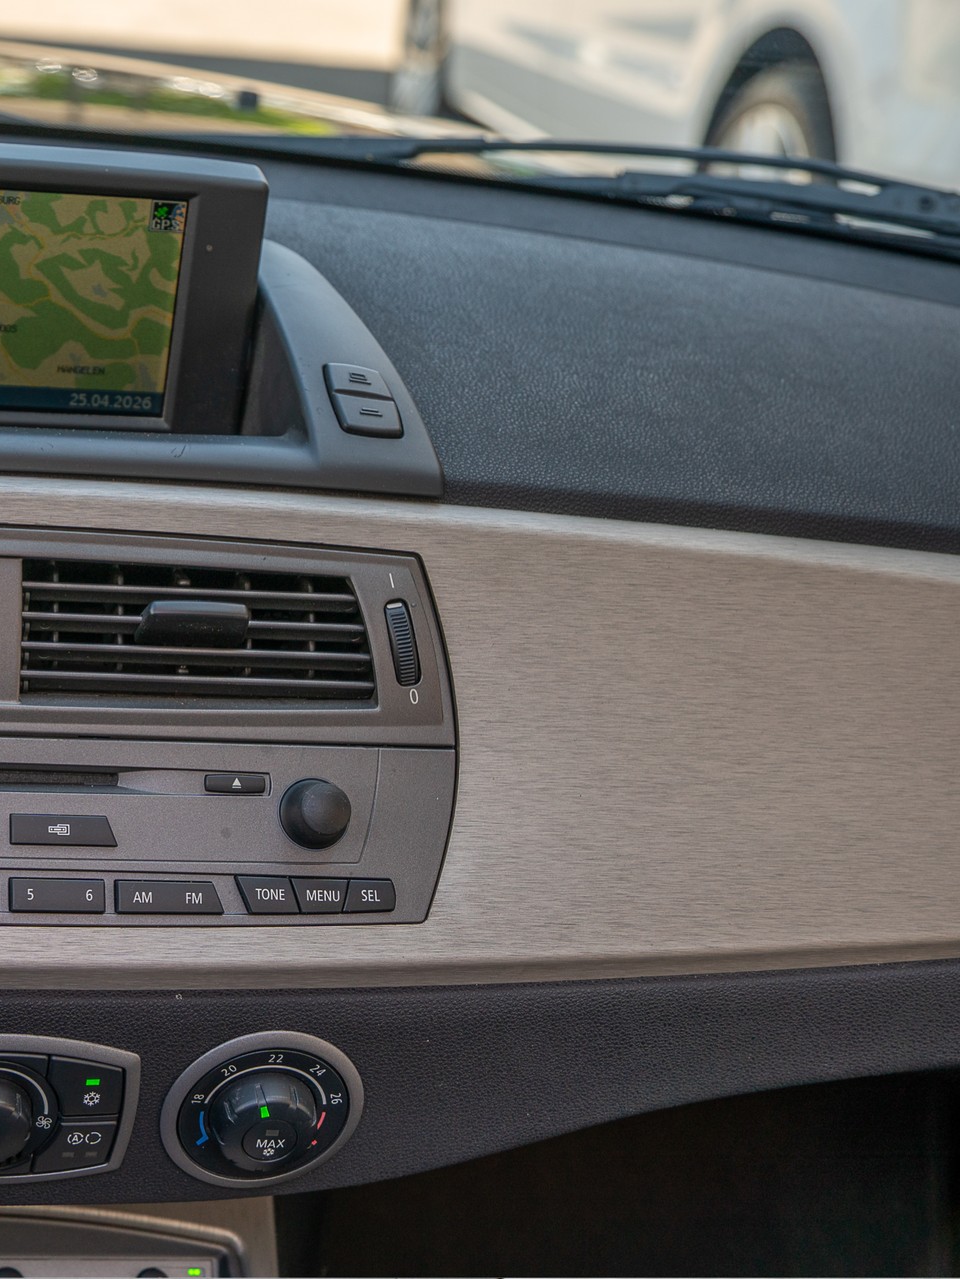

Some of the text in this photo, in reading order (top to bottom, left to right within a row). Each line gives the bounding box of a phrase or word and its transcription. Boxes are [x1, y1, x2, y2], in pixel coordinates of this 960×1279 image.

[152, 218, 180, 231] GPS
[69, 392, 153, 410] 25.04.2026
[27, 888, 93, 902] 5 6
[132, 891, 203, 904] AM FM
[255, 888, 286, 901] TONE
[306, 889, 340, 902] MENU
[361, 889, 381, 902] SEL
[267, 1053, 284, 1064] 22
[220, 1064, 238, 1078] 20
[308, 1063, 328, 1078] 24
[190, 1092, 206, 1105] 18
[329, 1091, 343, 1106] 26
[255, 1138, 286, 1149] MAX
